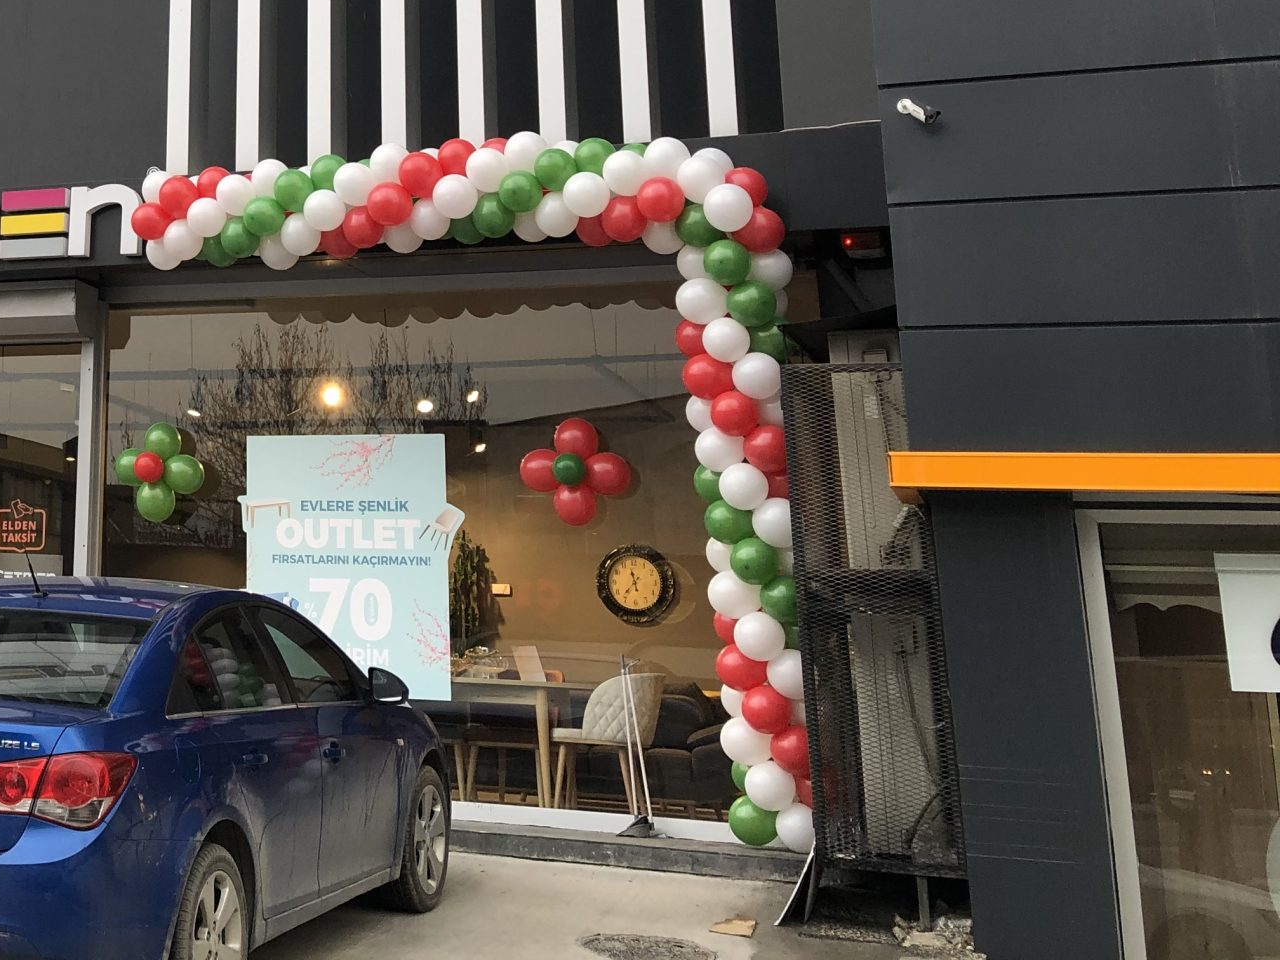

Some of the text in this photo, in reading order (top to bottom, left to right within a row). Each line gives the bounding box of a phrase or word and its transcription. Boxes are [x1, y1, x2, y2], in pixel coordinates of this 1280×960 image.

[300, 497, 410, 516] EVLERE ŞENLİK
[2, 520, 37, 531] ELDEN
[276, 517, 421, 550] OUTLET
[272, 554, 432, 568] FIRSATLARINI KAÇIRMAYIN!
